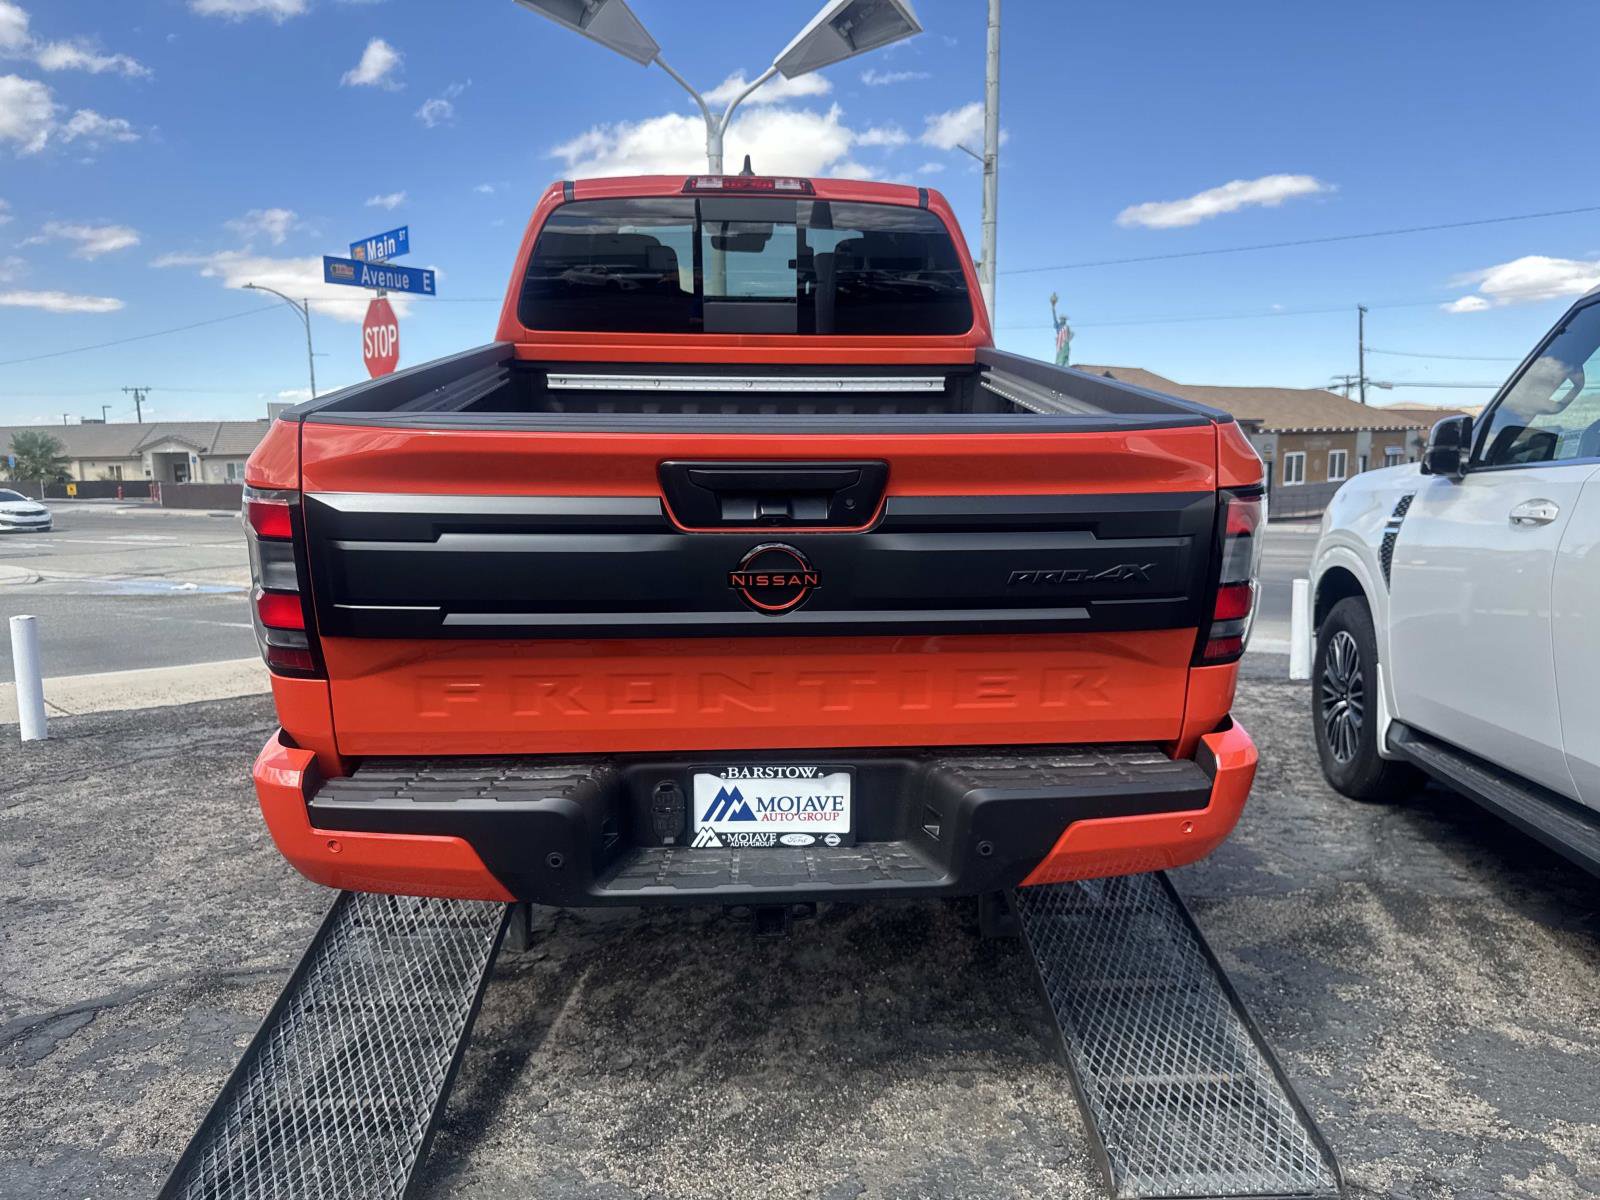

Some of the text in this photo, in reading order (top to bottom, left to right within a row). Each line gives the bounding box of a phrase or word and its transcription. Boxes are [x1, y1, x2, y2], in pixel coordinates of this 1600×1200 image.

[367, 230, 406, 262] Main ST
[361, 264, 410, 290] Avenue
[423, 272, 432, 292] E
[365, 324, 397, 359] STOP
[731, 573, 818, 586] NISSAN
[416, 666, 1113, 717] FRONTIER
[727, 766, 817, 779] BARSTOW
[755, 795, 844, 816] MOJAVE
[761, 812, 840, 822] AUTO GROUP
[726, 832, 777, 844] MOJAVE
